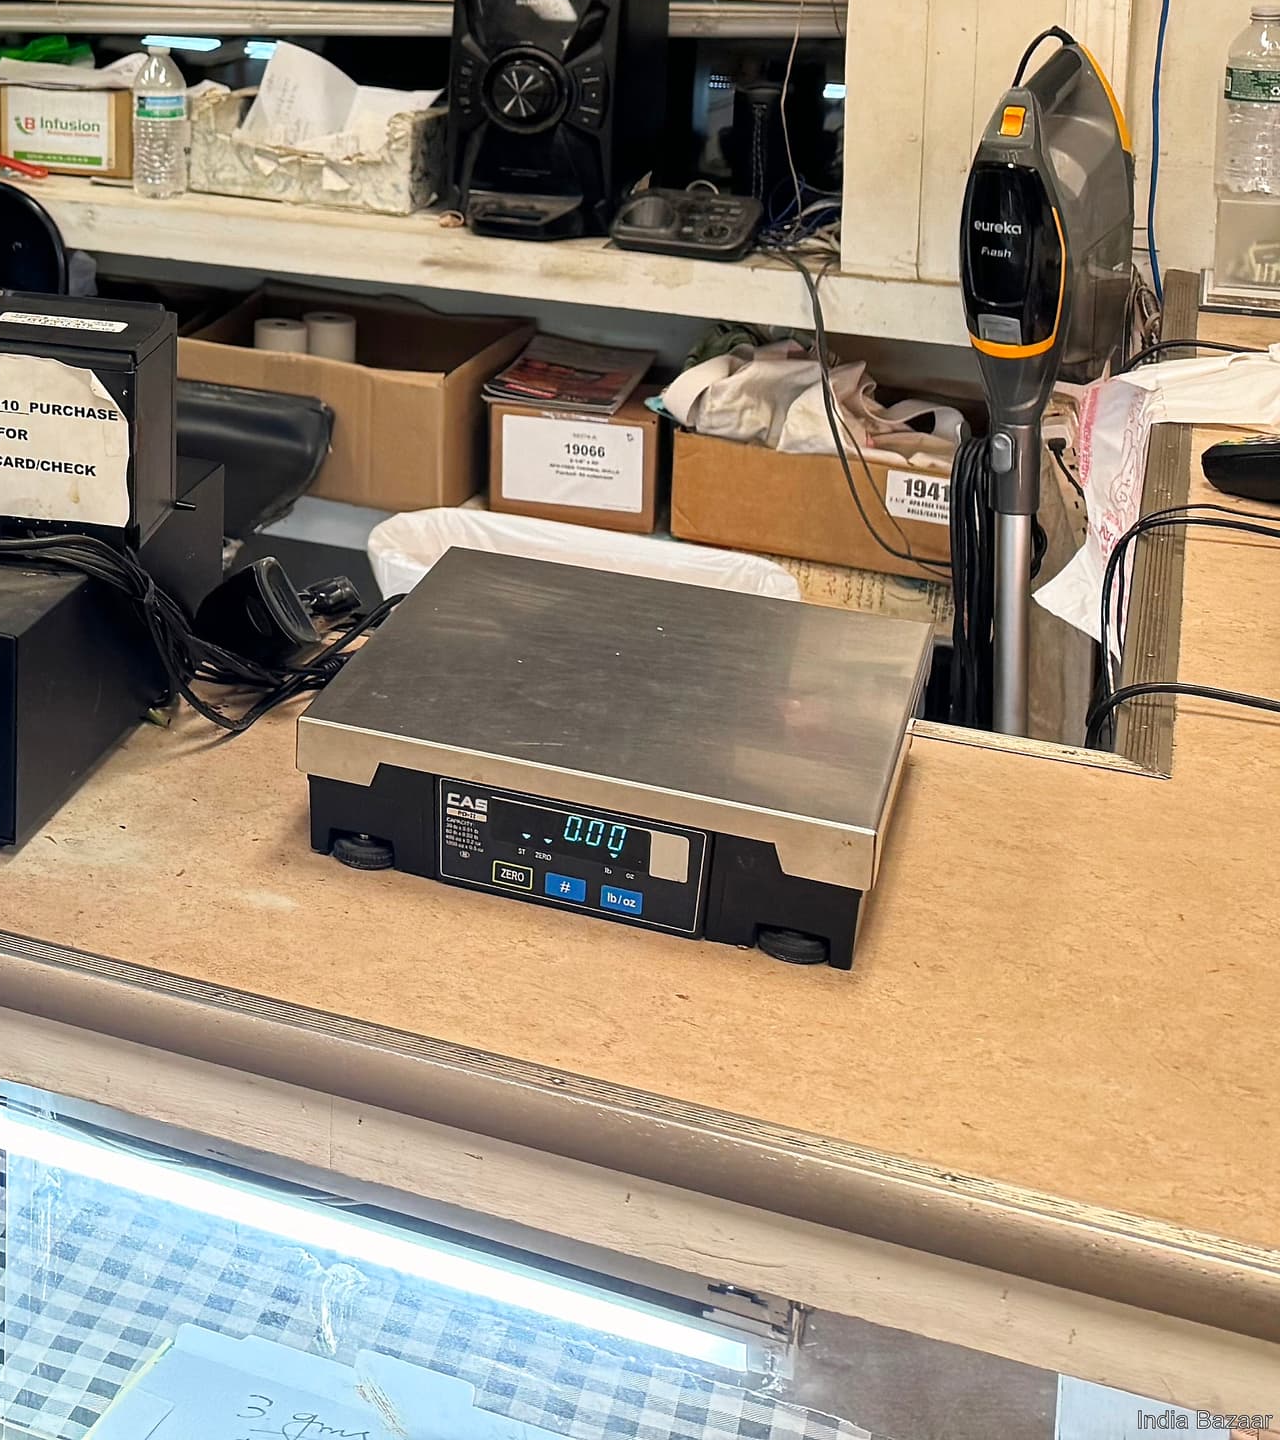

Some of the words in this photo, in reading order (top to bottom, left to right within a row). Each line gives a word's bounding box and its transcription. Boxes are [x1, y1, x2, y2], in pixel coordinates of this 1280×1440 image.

[40, 116, 100, 132] Infusion
[974, 220, 1022, 235] eureka
[980, 246, 1012, 259] Flash
[29, 402, 119, 421] PURCHASE
[564, 443, 605, 458] 19066
[446, 792, 488, 812] CAS
[563, 815, 627, 851] 0.00
[517, 847, 526, 856] ST
[534, 850, 552, 861] ZERO
[603, 866, 612, 875] lb
[625, 872, 635, 880] oz
[500, 868, 525, 883] ZERO
